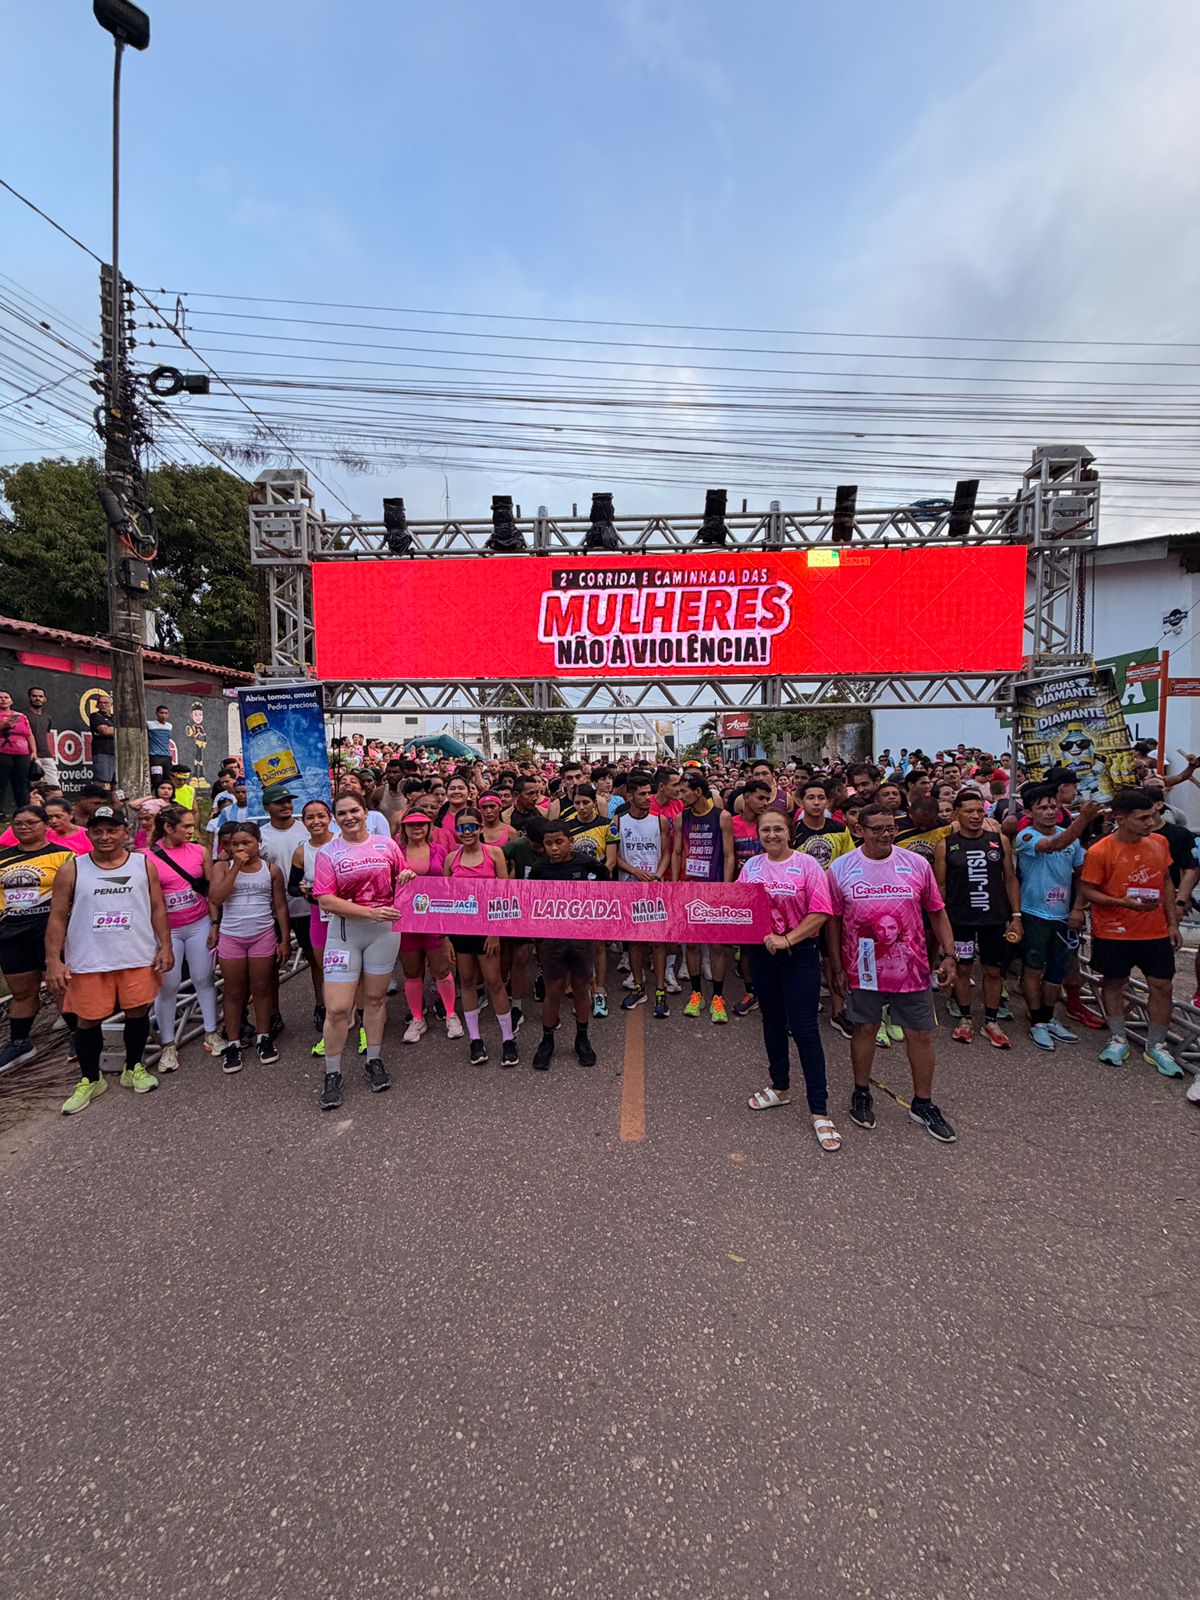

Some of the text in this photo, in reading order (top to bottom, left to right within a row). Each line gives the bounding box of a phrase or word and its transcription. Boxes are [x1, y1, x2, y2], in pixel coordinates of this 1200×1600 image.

[579, 571, 637, 587] CORRIDA
[642, 571, 650, 586] E
[655, 570, 736, 586] CAMINHADA
[742, 569, 769, 584] DAS
[543, 584, 789, 638] MULHERES
[558, 633, 769, 665] NÃO À VIOLÊNCIA!
[1043, 680, 1076, 694] ÁGUAS
[245, 691, 317, 703] Abriu, tomou, amou!
[1035, 687, 1098, 708] DIAMANTE
[267, 702, 320, 711] Pedra preciosa.
[1057, 700, 1080, 709] SABOR
[1039, 708, 1105, 730] DIAMANTE
[58, 766, 94, 780] rovedo
[262, 764, 298, 782] Diamante
[341, 857, 388, 870] CasaRosa
[767, 880, 797, 891] aRosa
[966, 850, 991, 912] JIU-JITSU
[94, 886, 134, 896] PENALTY
[855, 884, 912, 895] CasaRosa
[454, 901, 478, 909] JACIR
[489, 897, 520, 912] NÃO À
[533, 900, 621, 919] LARGADA
[633, 898, 665, 915] NÃO À
[489, 910, 521, 920] VIOLÊNCIA!
[633, 912, 667, 923] VIOLÊNCIA!
[692, 906, 752, 919] CasaRosa
[97, 916, 128, 925] 0946
